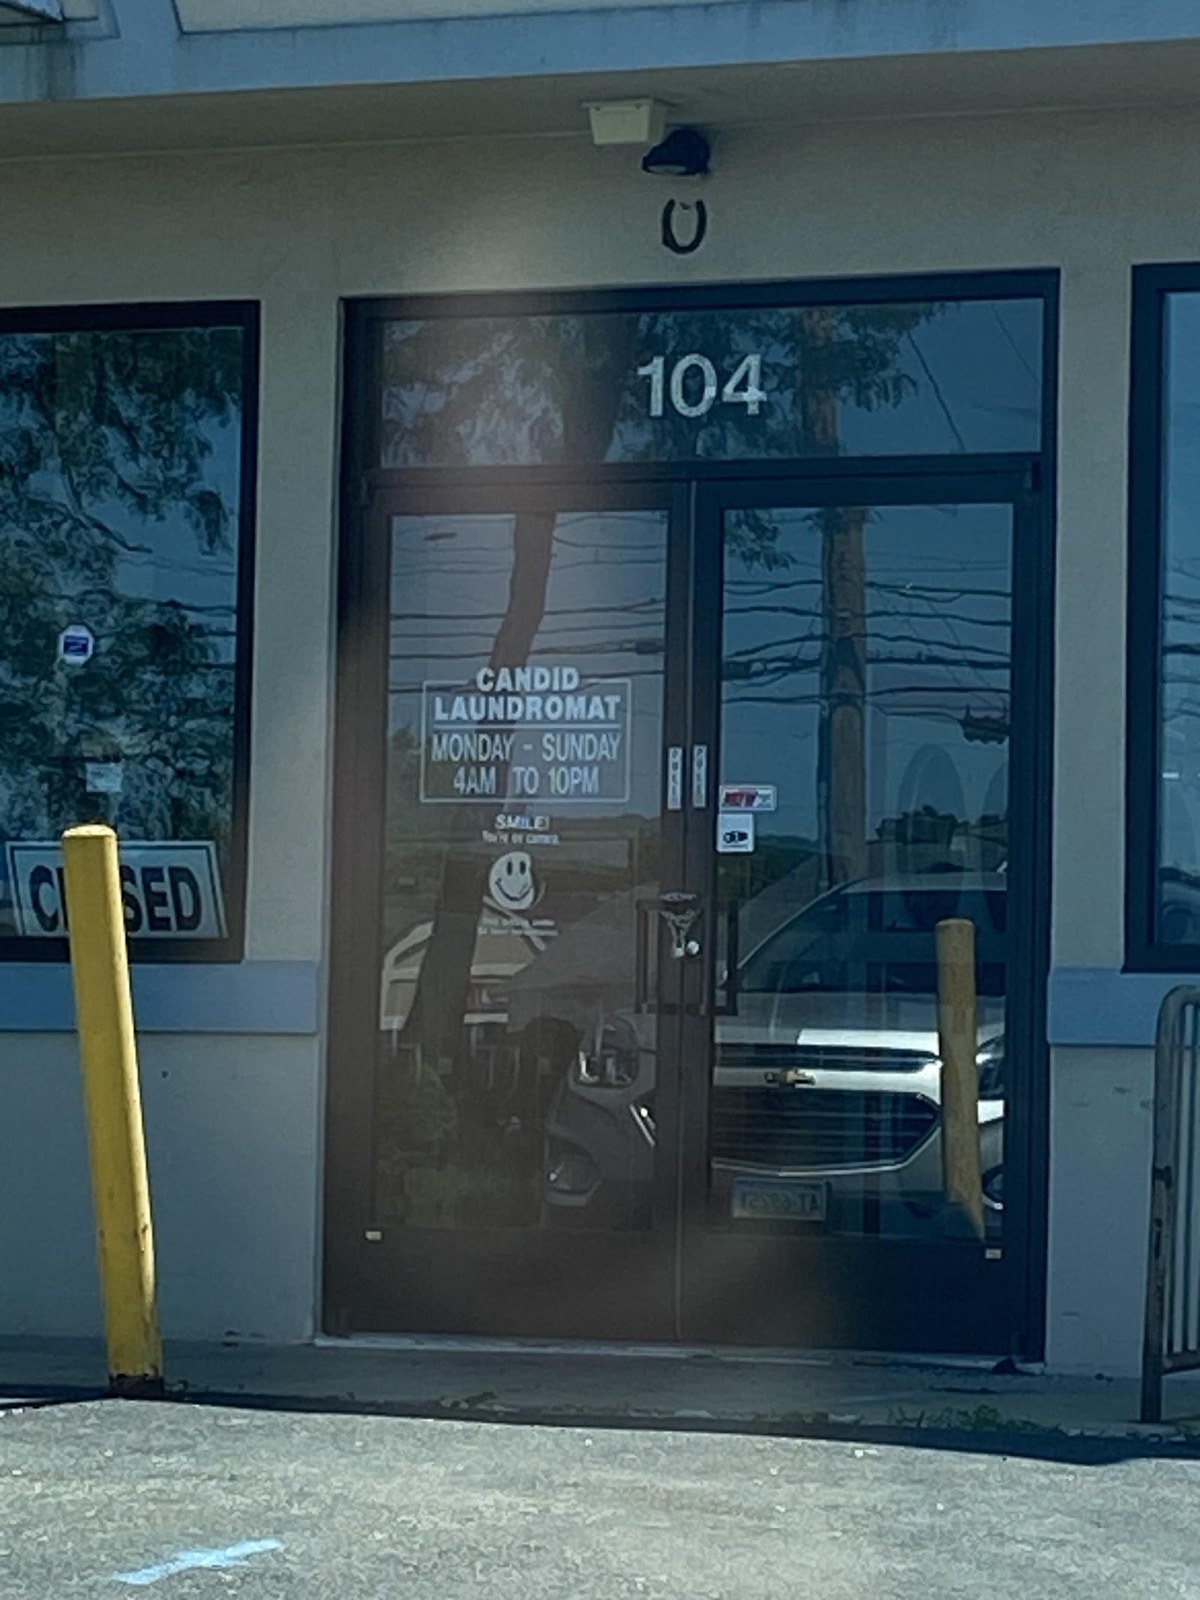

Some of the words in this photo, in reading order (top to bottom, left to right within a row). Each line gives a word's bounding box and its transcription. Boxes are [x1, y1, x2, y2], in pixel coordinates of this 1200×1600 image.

[637, 353, 767, 417] 104
[476, 667, 580, 692] CANDID
[434, 696, 621, 721] LAUNDROMAT
[431, 733, 515, 763] MONDAY
[542, 733, 622, 762] SUNDAY
[453, 766, 496, 795] 4AM
[512, 766, 539, 795] TO
[548, 766, 599, 794] 10PM
[29, 865, 202, 932] CSED
